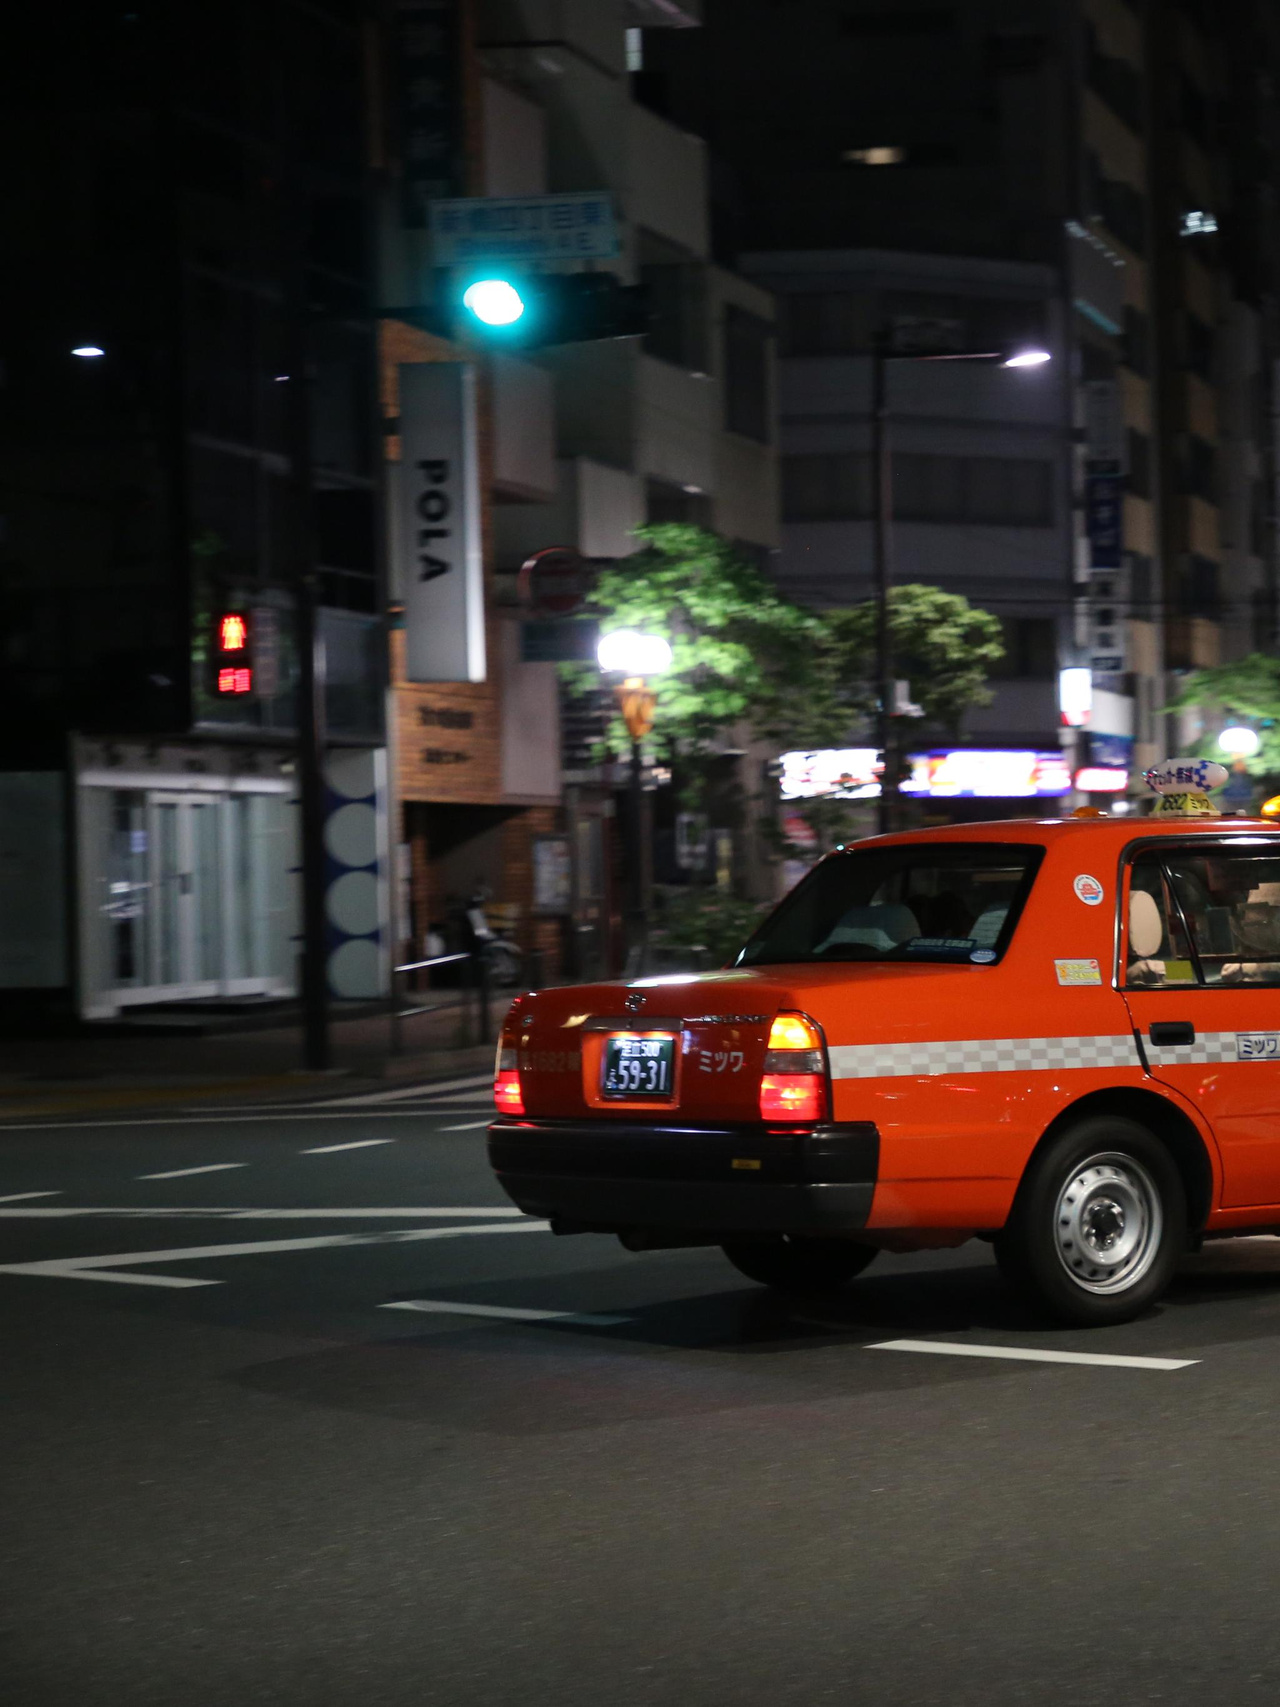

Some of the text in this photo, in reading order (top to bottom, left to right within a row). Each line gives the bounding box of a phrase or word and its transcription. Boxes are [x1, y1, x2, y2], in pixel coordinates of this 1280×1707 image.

[417, 459, 452, 582] POLA
[1243, 1038, 1278, 1055] ミツワ
[618, 1060, 667, 1090] 59-31
[699, 1051, 745, 1073] ミツワ
